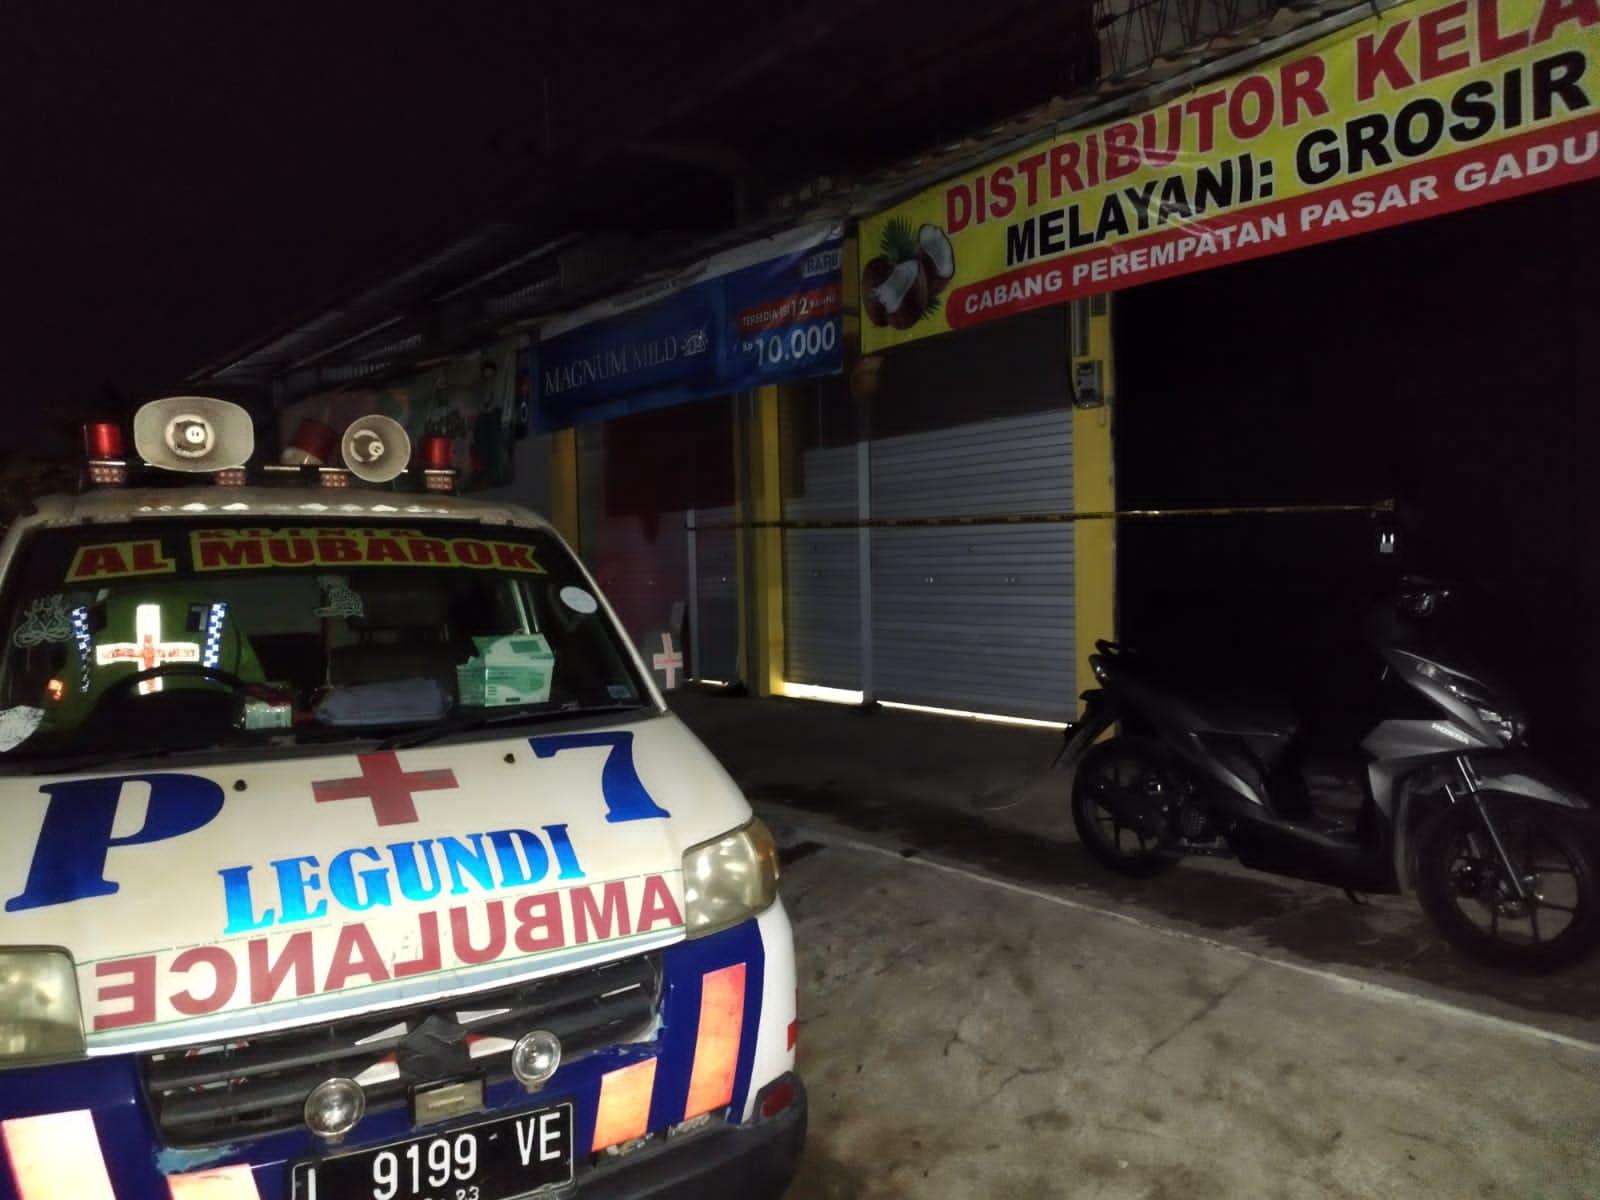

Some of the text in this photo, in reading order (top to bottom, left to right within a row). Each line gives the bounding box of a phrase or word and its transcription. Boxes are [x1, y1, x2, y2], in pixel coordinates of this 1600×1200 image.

[945, 55, 1330, 236] DISTRIBUTOR
[1006, 50, 1591, 267] MELAYANI: GROSIR
[964, 129, 1600, 316] CABANG PEREMPATAN PASAR GADU
[544, 350, 629, 394] MAGNUM
[632, 335, 678, 371] MILD
[755, 320, 836, 368] 10.000
[66, 535, 543, 582] AL MUBAROK
[3, 730, 671, 913] P 7
[218, 823, 586, 935] LEGUNDI
[372, 1132, 478, 1200] 9199
[515, 1111, 562, 1168] VE
